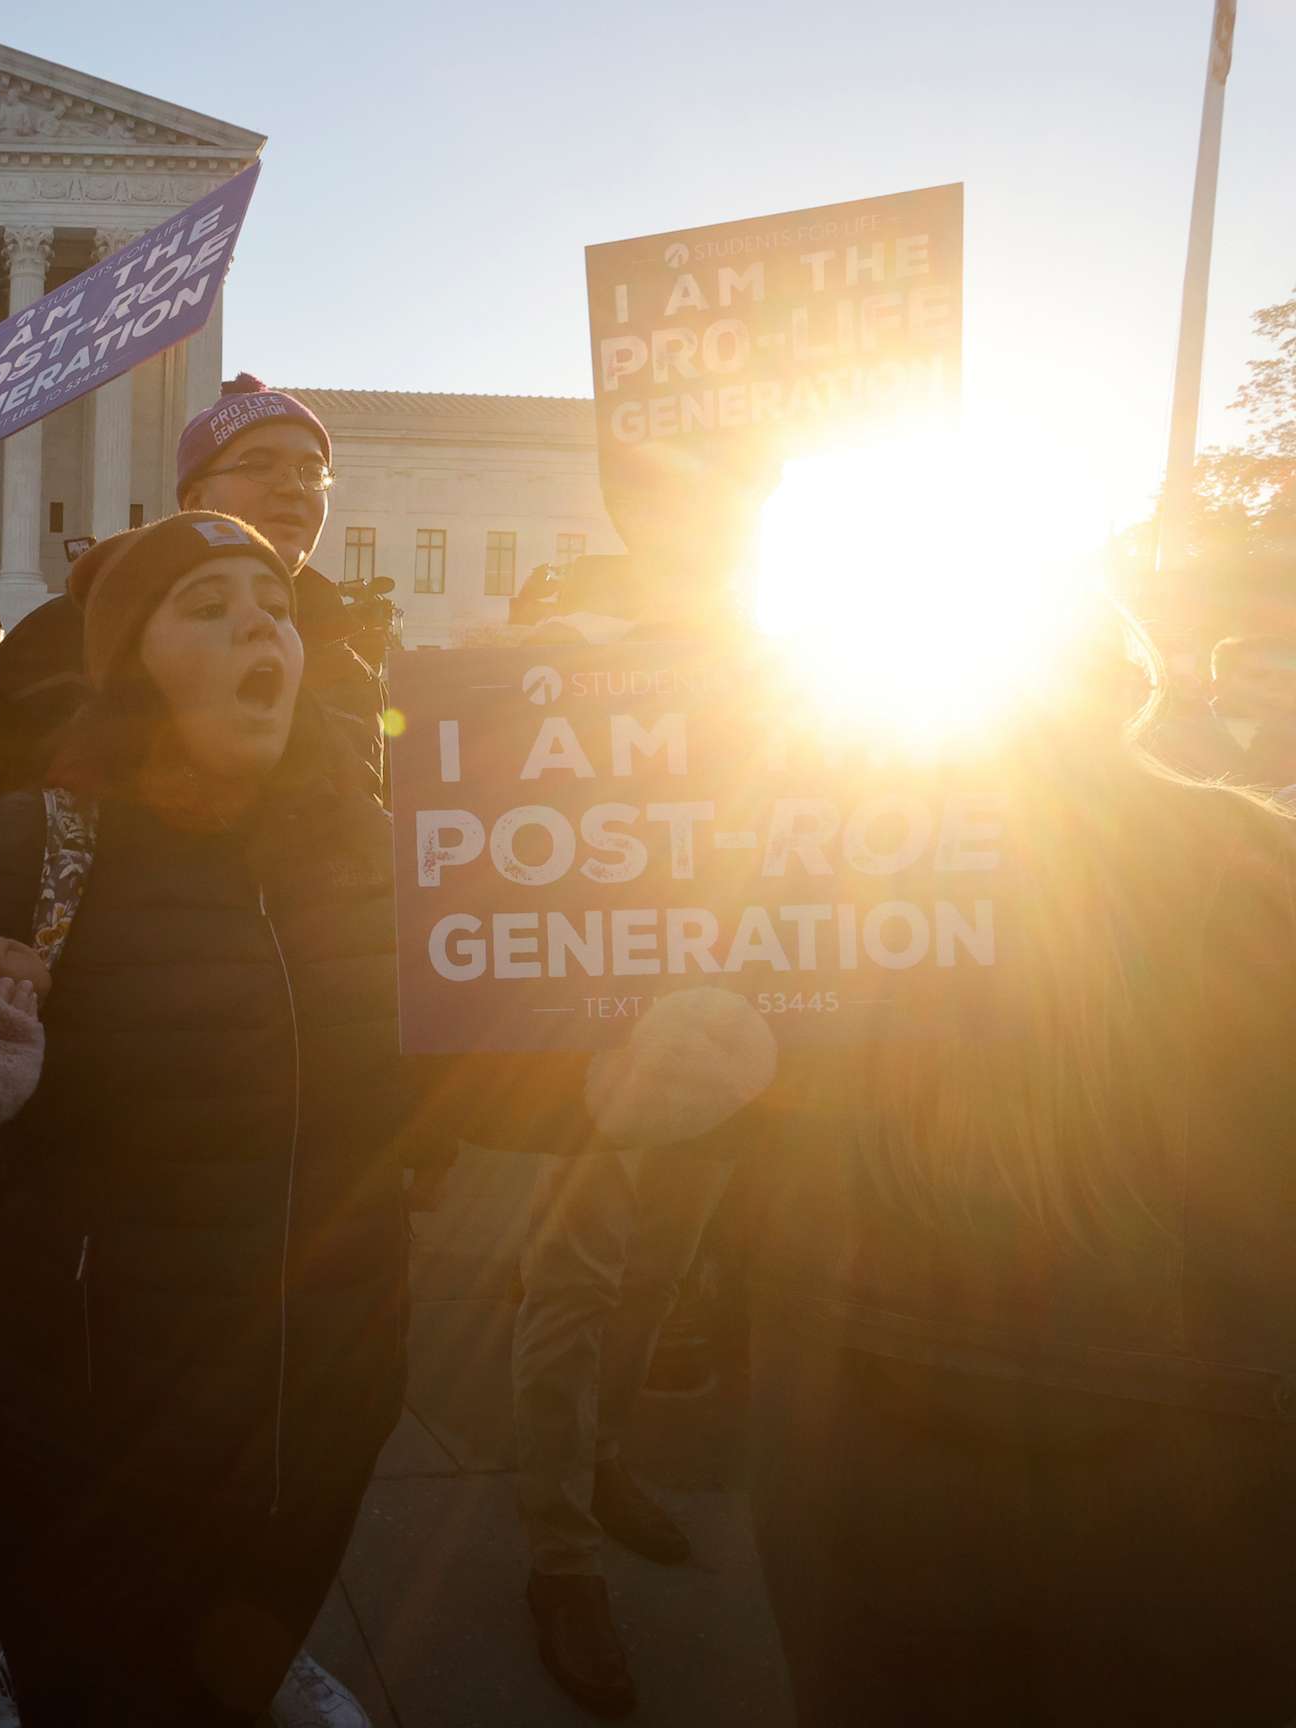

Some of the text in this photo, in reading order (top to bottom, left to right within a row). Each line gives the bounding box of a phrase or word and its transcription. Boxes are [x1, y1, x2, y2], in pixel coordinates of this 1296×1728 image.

[34, 214, 189, 314] STUDENTS FOR LIFE
[693, 214, 881, 262] STUDENTS FOR LIFE
[0, 291, 86, 359] AM
[112, 205, 225, 289] THE
[615, 233, 929, 324] I AM THE
[600, 284, 952, 394] PRO-LIFE
[12, 401, 39, 424] LIFE
[64, 363, 109, 393] 53445
[210, 395, 281, 432] PRO-LIFE
[214, 404, 288, 446] GENERATION
[438, 719, 461, 782] I
[519, 711, 689, 780] AM
[415, 794, 1003, 888] POST-ROE
[427, 900, 997, 983] GENERATION
[584, 997, 641, 1018] TEXT
[757, 990, 840, 1014] 53445
